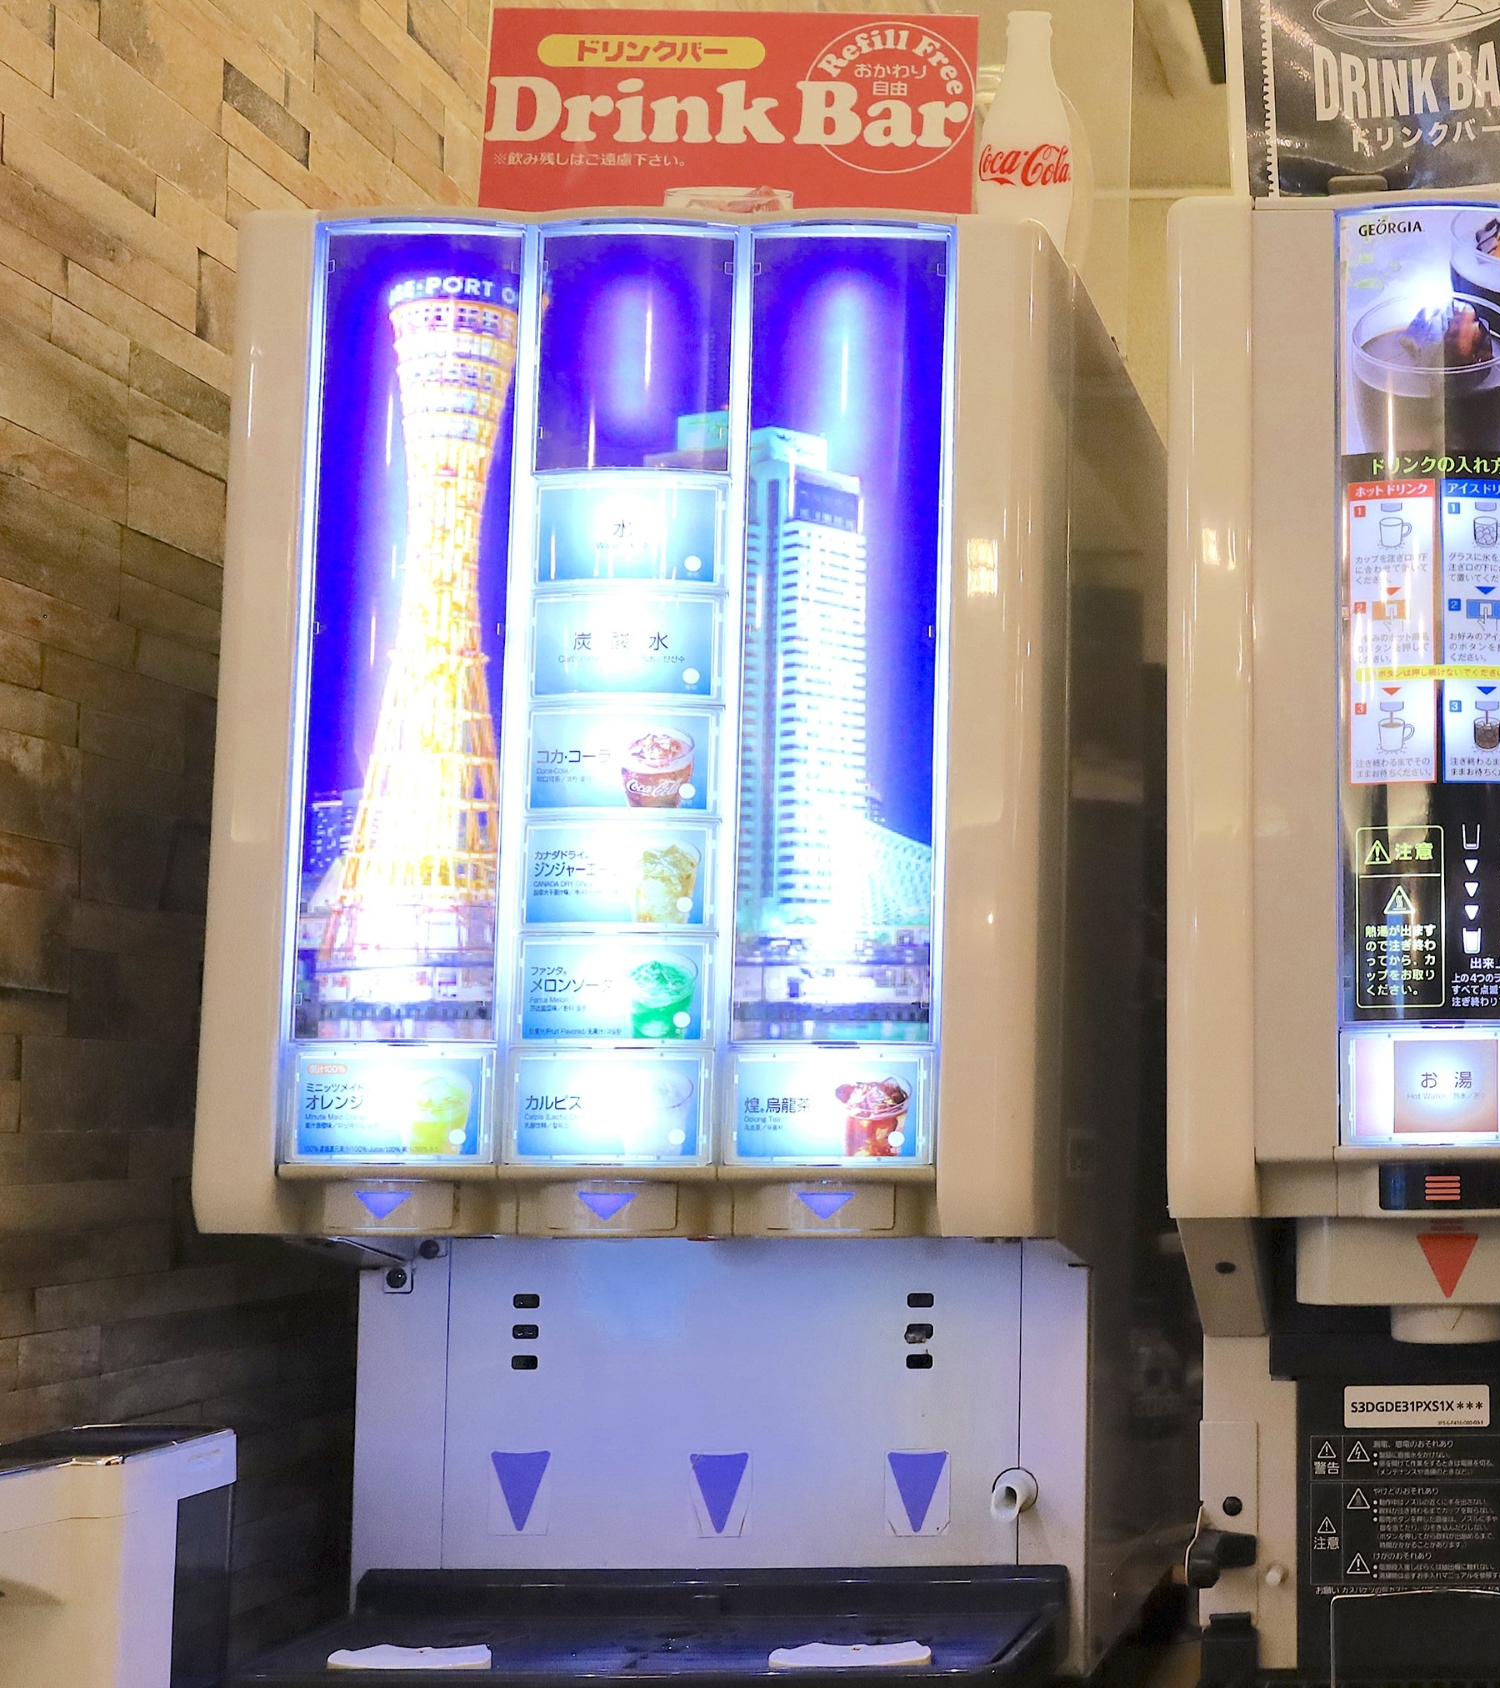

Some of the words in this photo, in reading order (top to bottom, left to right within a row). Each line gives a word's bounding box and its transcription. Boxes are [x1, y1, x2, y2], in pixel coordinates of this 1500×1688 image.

[577, 39, 728, 63] ドリンクバー
[817, 29, 909, 78] Refill
[912, 35, 963, 95] Free
[854, 63, 927, 79] おかわり
[873, 81, 908, 96] 自由
[1313, 43, 1440, 121] DRINK
[484, 75, 786, 146] Drink
[792, 80, 969, 148] Bar
[1394, 842, 1434, 861] 注意
[534, 862, 616, 878] ジンジャーエー
[525, 1095, 583, 1110] カルピス
[1314, 1461, 1340, 1475] 警告
[1313, 1536, 1340, 1550] 注意
